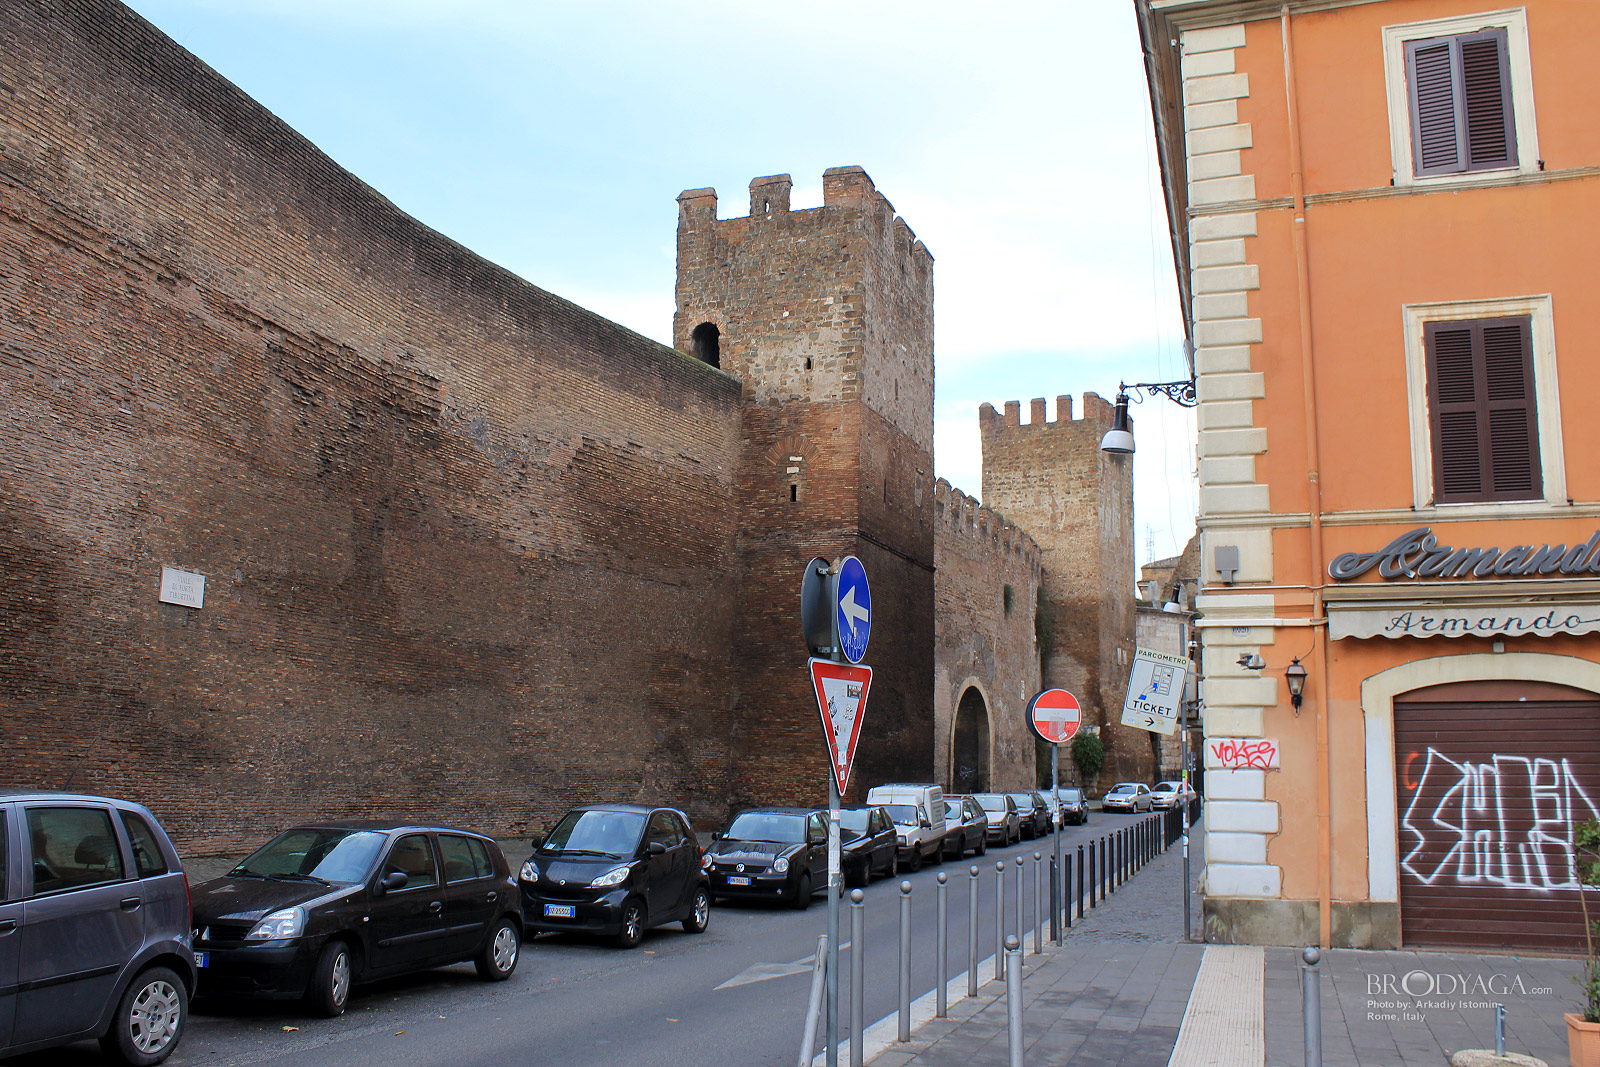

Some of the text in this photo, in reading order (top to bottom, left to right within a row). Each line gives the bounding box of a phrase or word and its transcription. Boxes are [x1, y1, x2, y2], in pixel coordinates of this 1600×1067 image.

[1385, 611, 1584, 632] Armando
[1138, 649, 1187, 665] PARCOMETRO
[1133, 700, 1172, 716] TICKET
